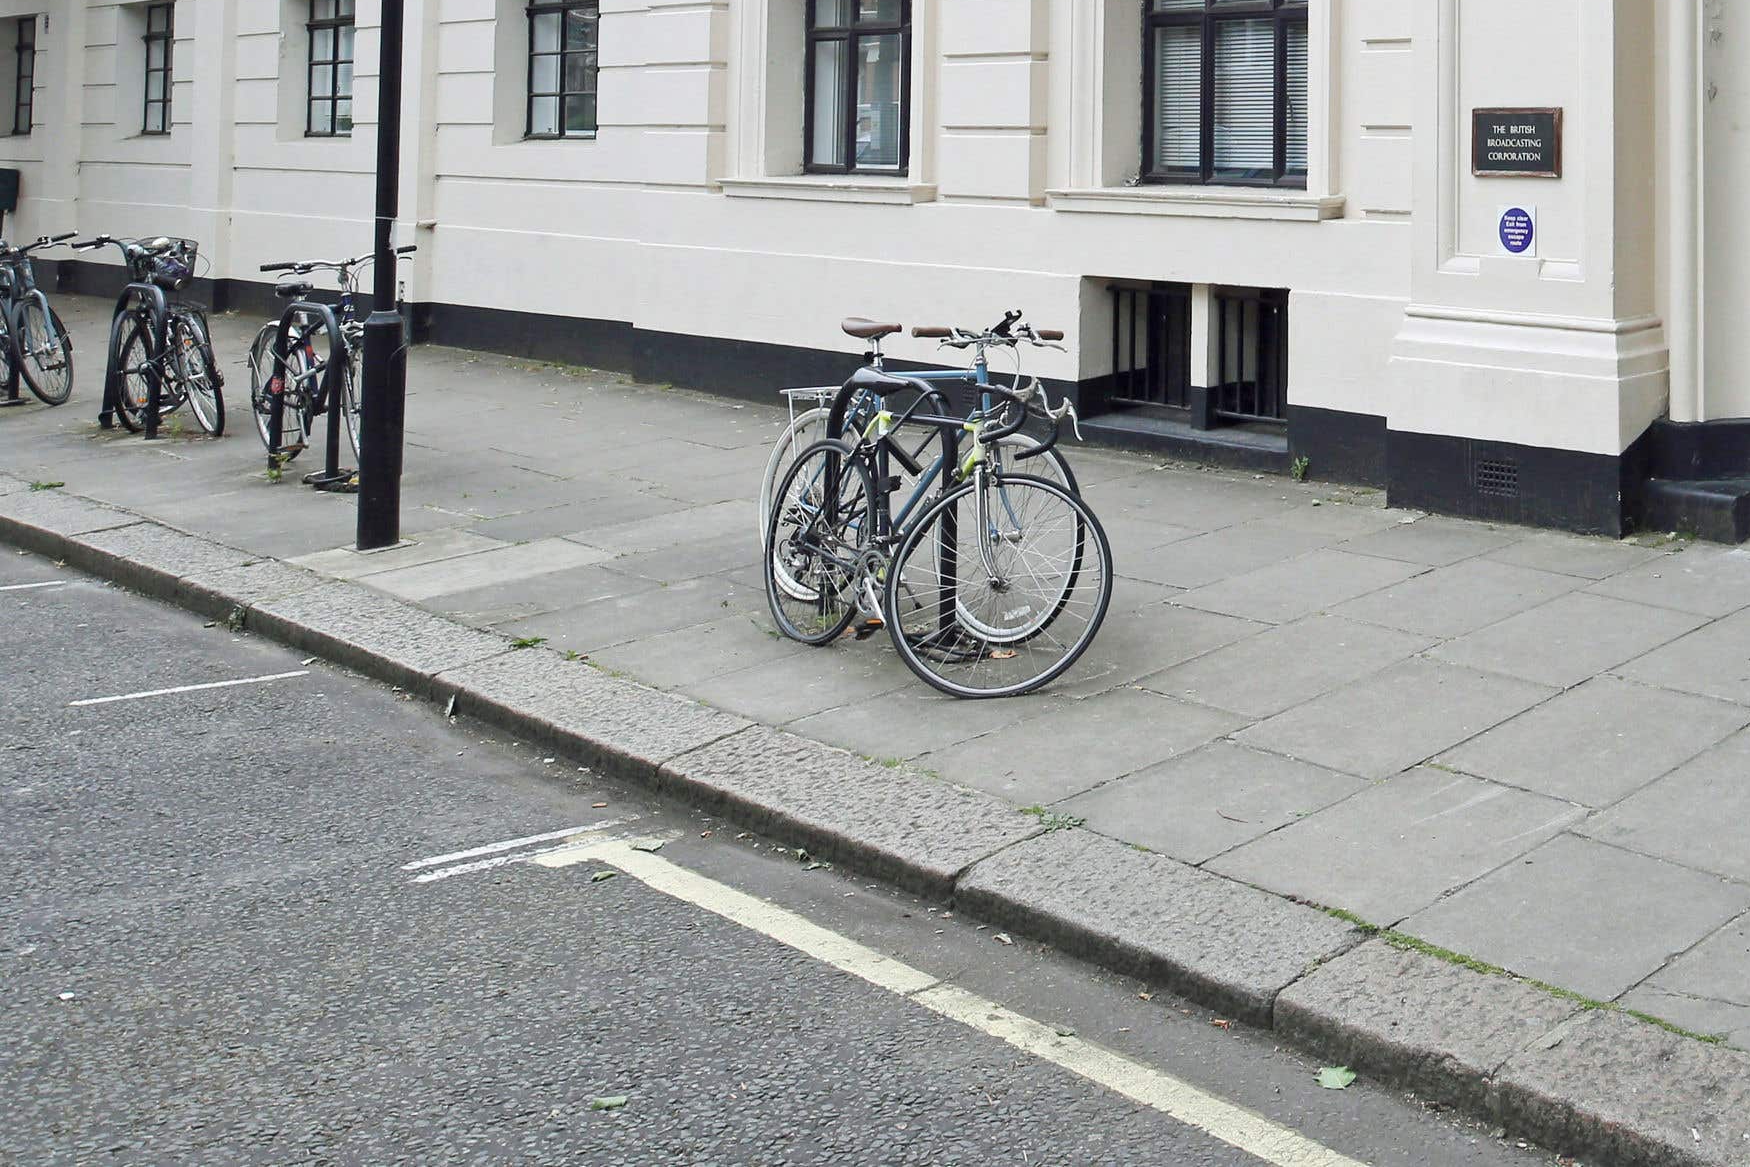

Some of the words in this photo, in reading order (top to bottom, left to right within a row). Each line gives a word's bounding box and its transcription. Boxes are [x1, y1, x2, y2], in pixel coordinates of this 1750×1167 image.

[1492, 125, 1506, 134] THE
[1510, 125, 1536, 134] BRITISH
[1487, 138, 1542, 147] BROADCASTING
[1488, 152, 1541, 161] CORPORATION
